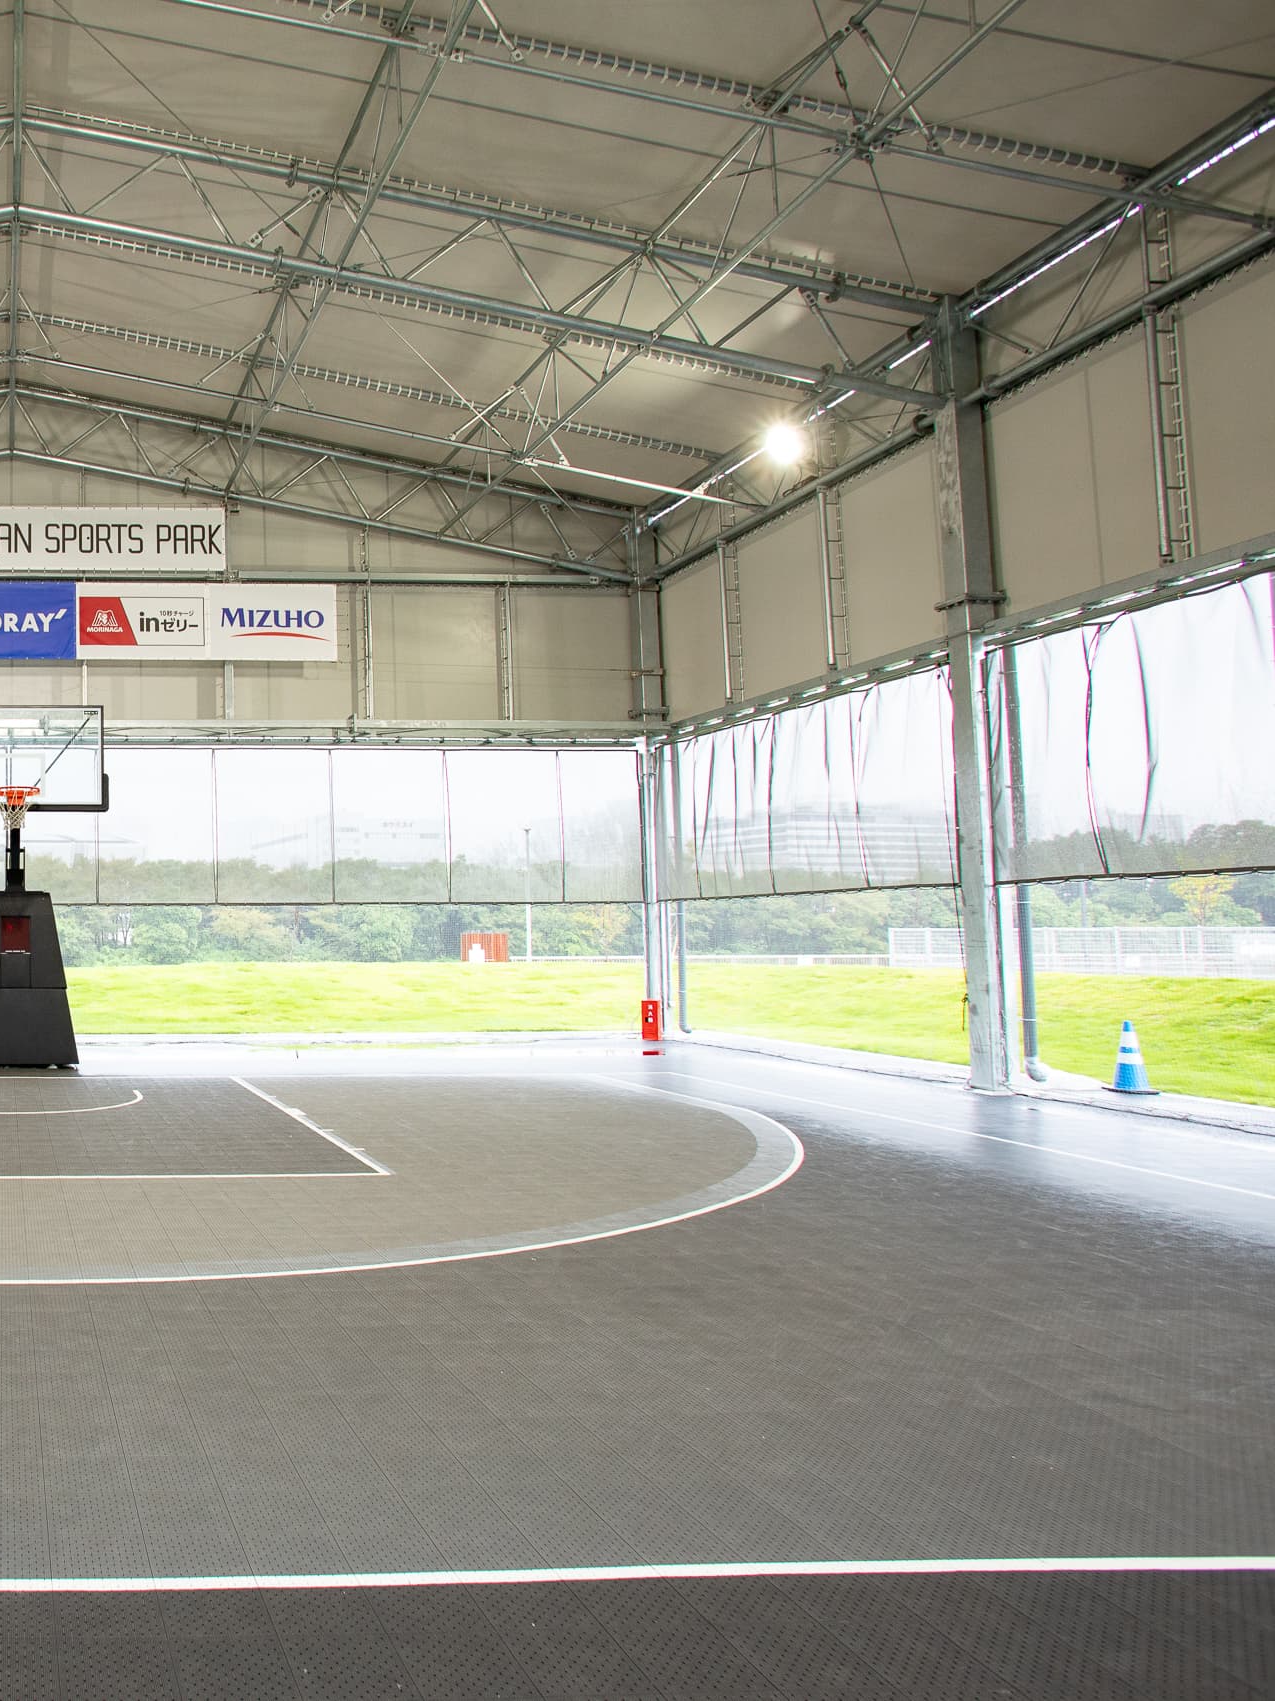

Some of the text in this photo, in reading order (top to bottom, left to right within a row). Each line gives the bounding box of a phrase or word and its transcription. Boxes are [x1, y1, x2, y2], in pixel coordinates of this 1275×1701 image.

[44, 523, 144, 554] SPORTS
[156, 524, 223, 555] PARK
[221, 607, 325, 629] MIZUHO
